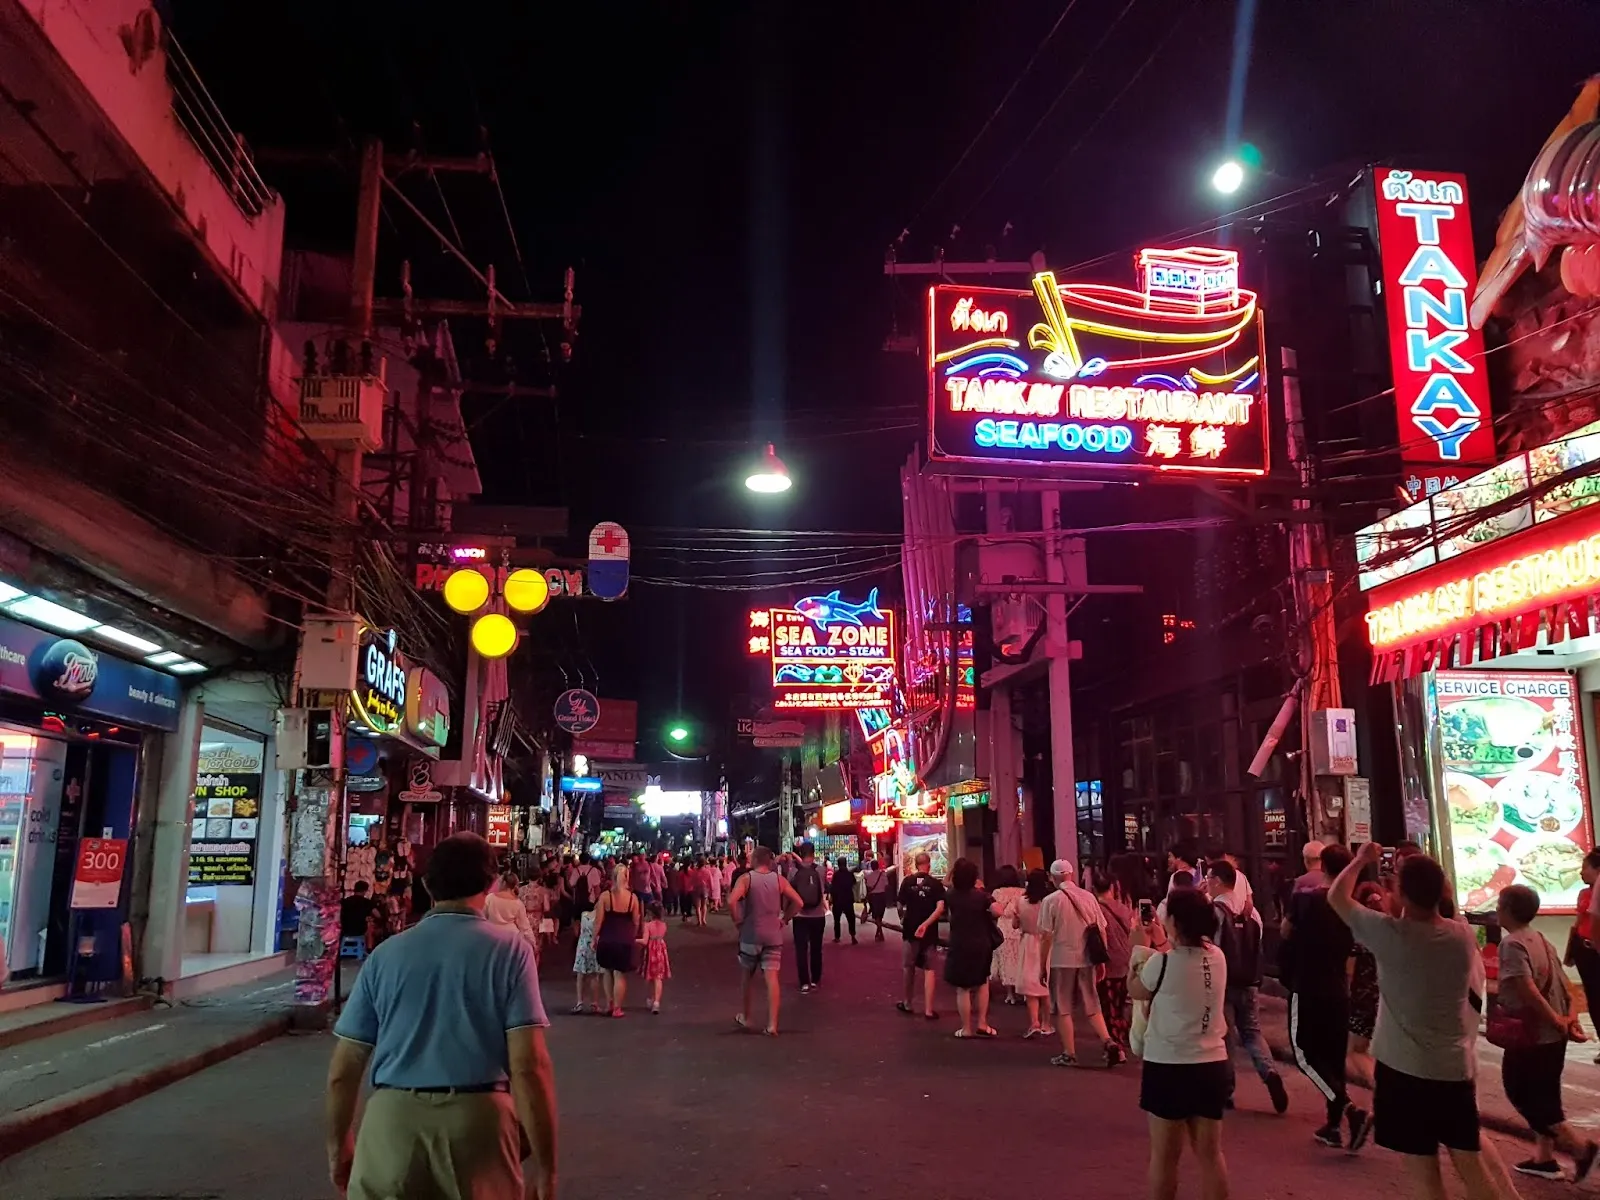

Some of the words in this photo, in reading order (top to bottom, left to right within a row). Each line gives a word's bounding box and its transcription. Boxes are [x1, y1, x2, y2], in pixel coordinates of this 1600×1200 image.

[1382, 170, 1463, 204] ตังเก
[1397, 204, 1481, 460] TANKAY
[945, 376, 1064, 417] TANKAY
[1067, 385, 1254, 425] RESTAURANT
[974, 419, 1133, 453] SEAFOOD
[775, 626, 816, 646] SEA
[827, 626, 888, 646] ZONE
[780, 646, 802, 656] SEA
[805, 646, 836, 656] FOOD
[849, 646, 885, 656] STEAK
[54, 652, 97, 693] Boots
[367, 643, 406, 706] GRAFS
[128, 684, 149, 703] beauty
[154, 695, 176, 709] skincare
[1437, 681, 1499, 694] SERVICE
[1505, 682, 1568, 695] CHARGE
[223, 758, 259, 769] GOLD
[215, 786, 248, 797] SHOP
[82, 851, 120, 869] 300
[1203, 957, 1212, 989] AMOR
